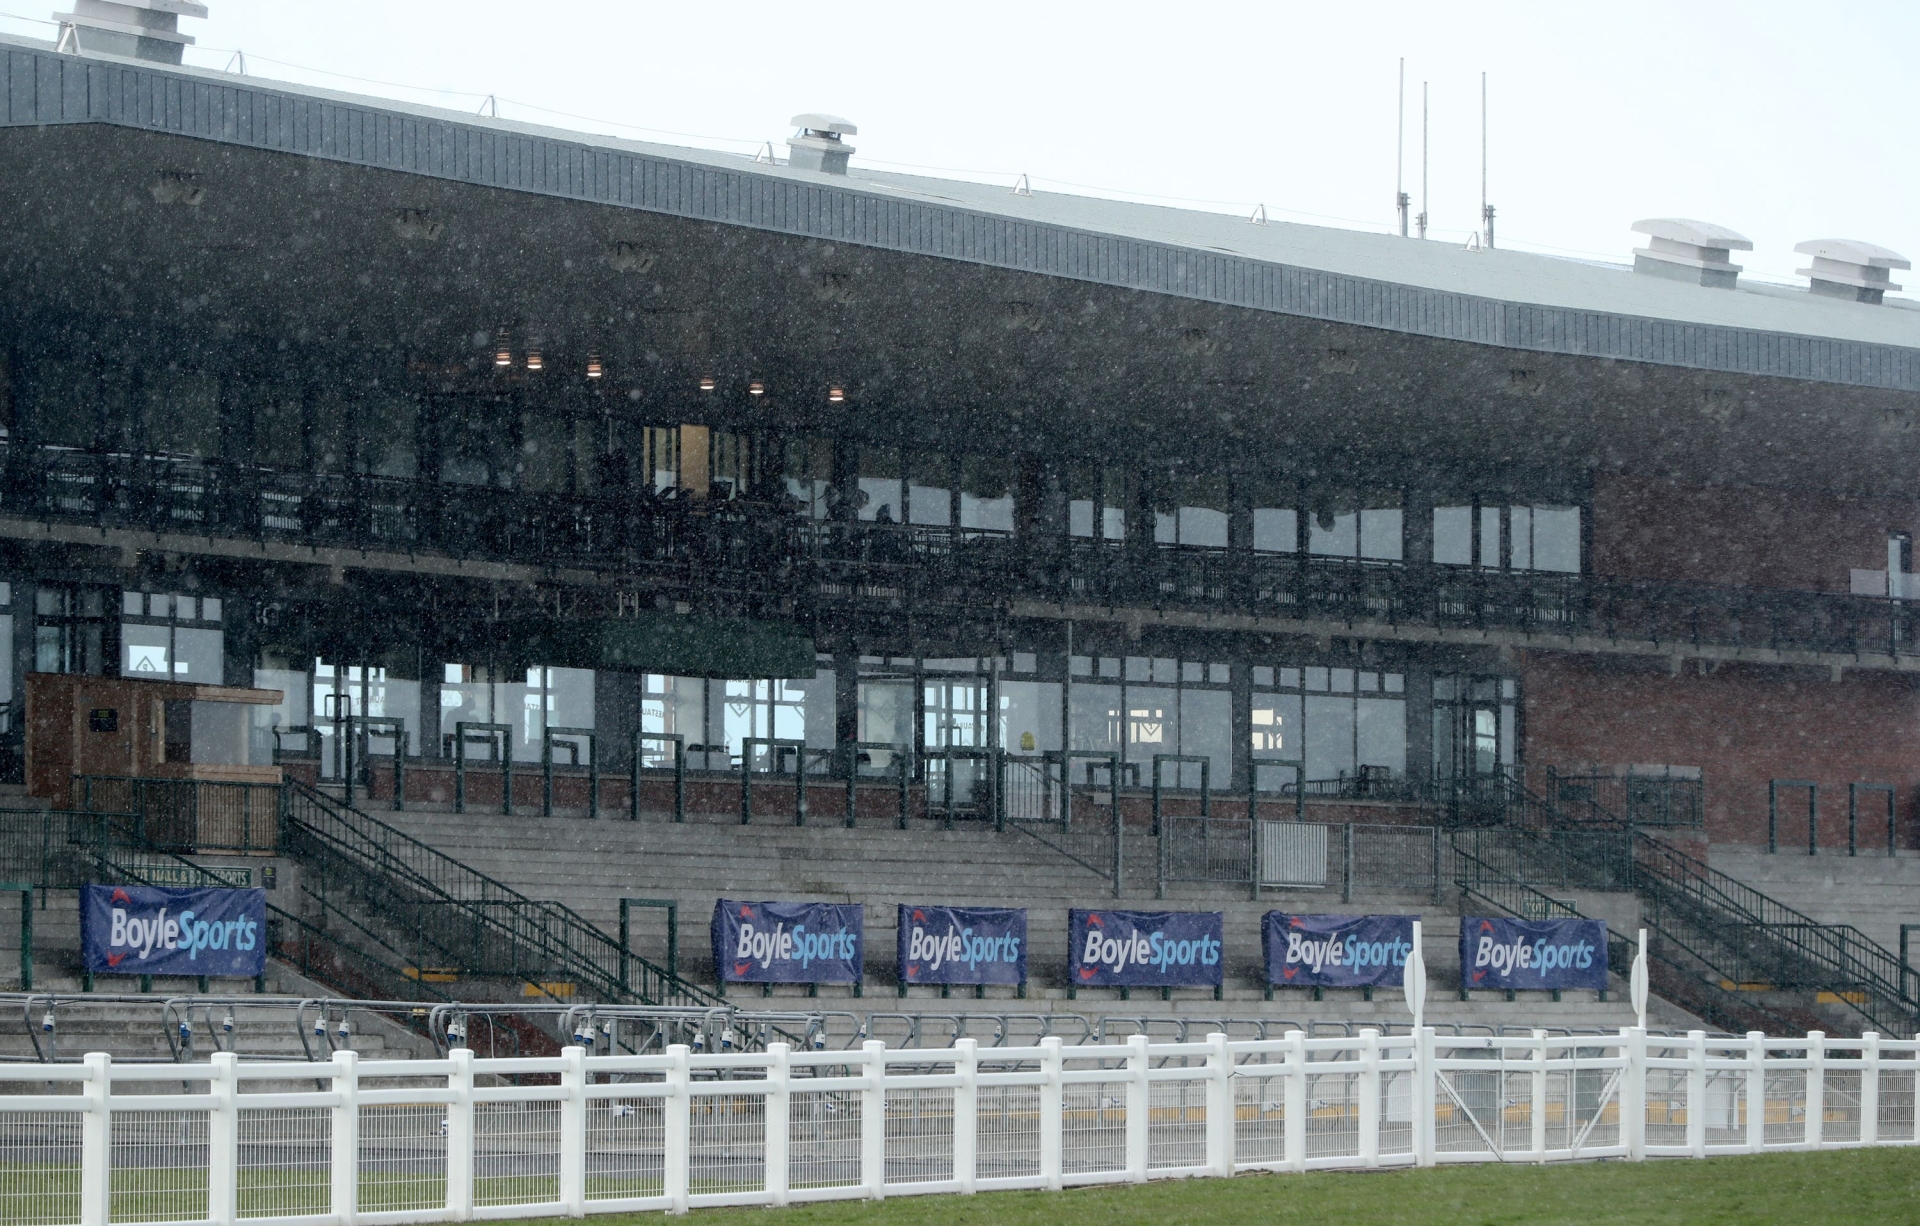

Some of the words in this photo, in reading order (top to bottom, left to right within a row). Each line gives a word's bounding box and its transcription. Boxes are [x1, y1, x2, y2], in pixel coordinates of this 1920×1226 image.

[152, 869, 179, 882] HALL
[180, 870, 188, 883] &
[110, 907, 258, 960] BoyleSports
[737, 922, 857, 969] BoyleSports
[909, 925, 1021, 971] BoyleSports
[1083, 929, 1221, 973] BoyleSports
[1286, 932, 1412, 975] BoyleSports
[1475, 935, 1596, 977] BoyleSports
